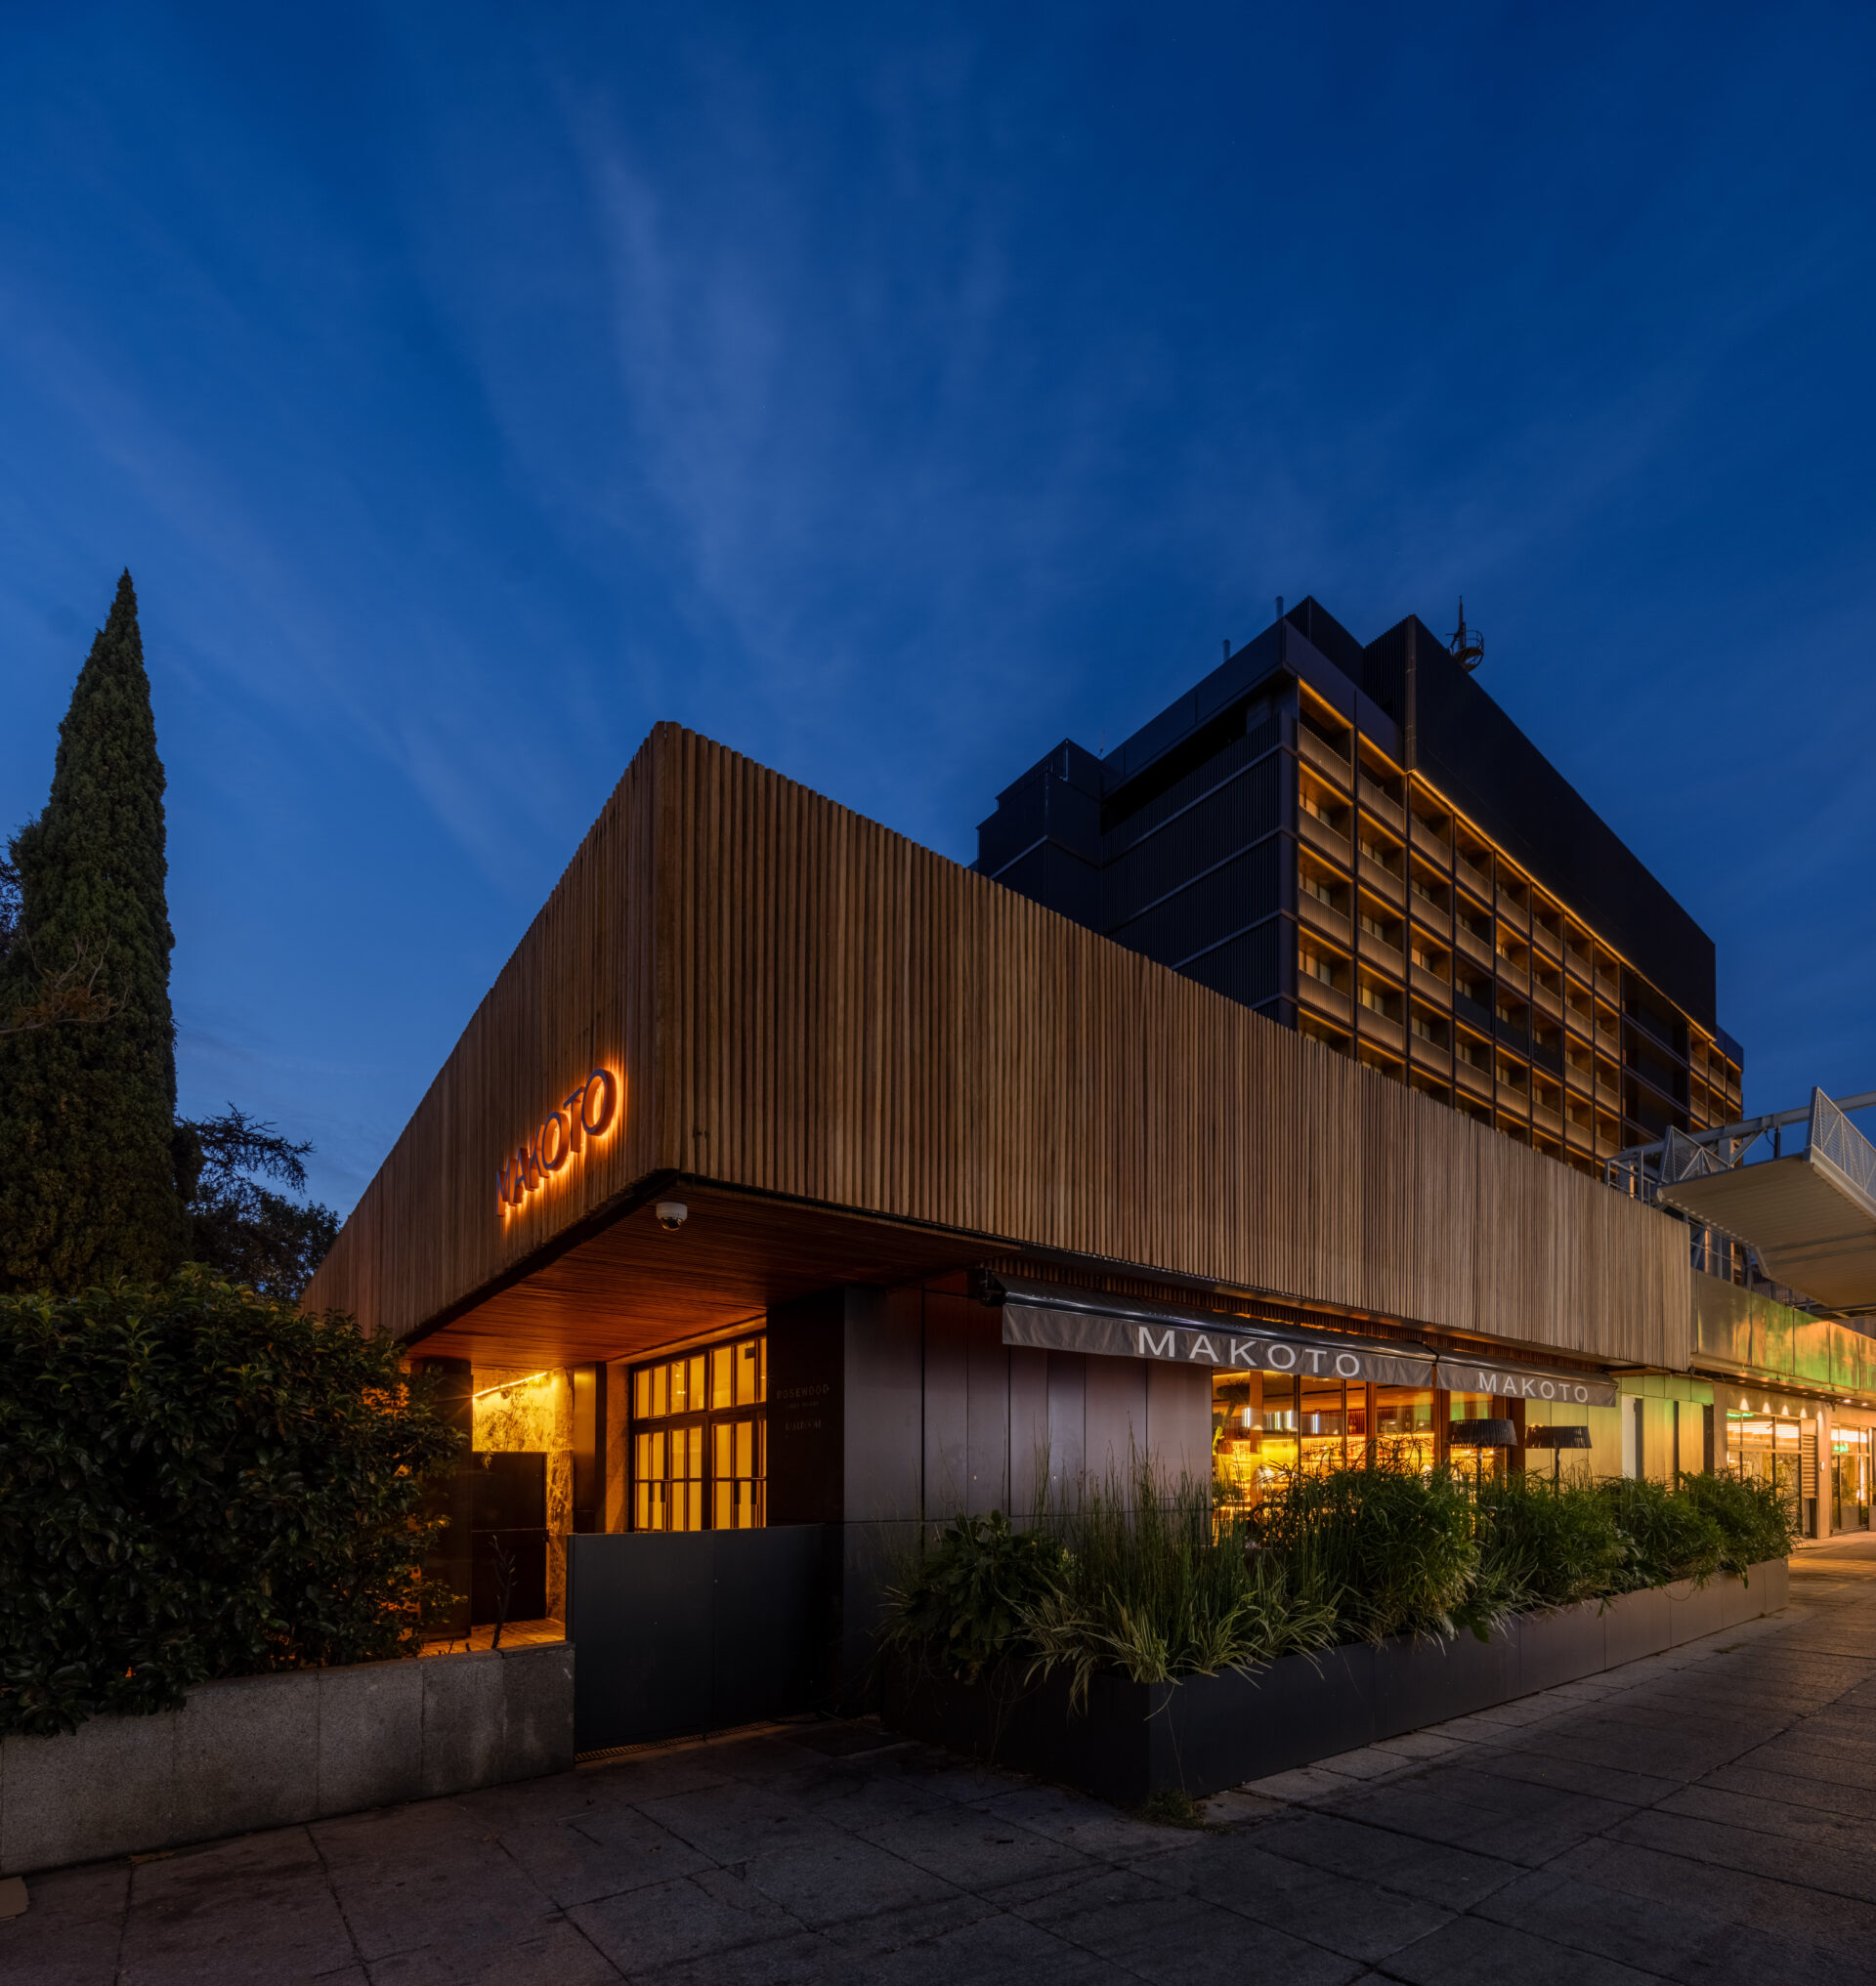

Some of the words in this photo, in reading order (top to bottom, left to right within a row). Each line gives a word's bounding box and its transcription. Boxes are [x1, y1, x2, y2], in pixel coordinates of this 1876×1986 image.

[495, 1068, 618, 1217] MAKOTO
[1138, 1326, 1360, 1377] MAKOTO
[776, 1383, 829, 1400] ROSEWOOD
[1478, 1372, 1589, 1403] MAKOTO
